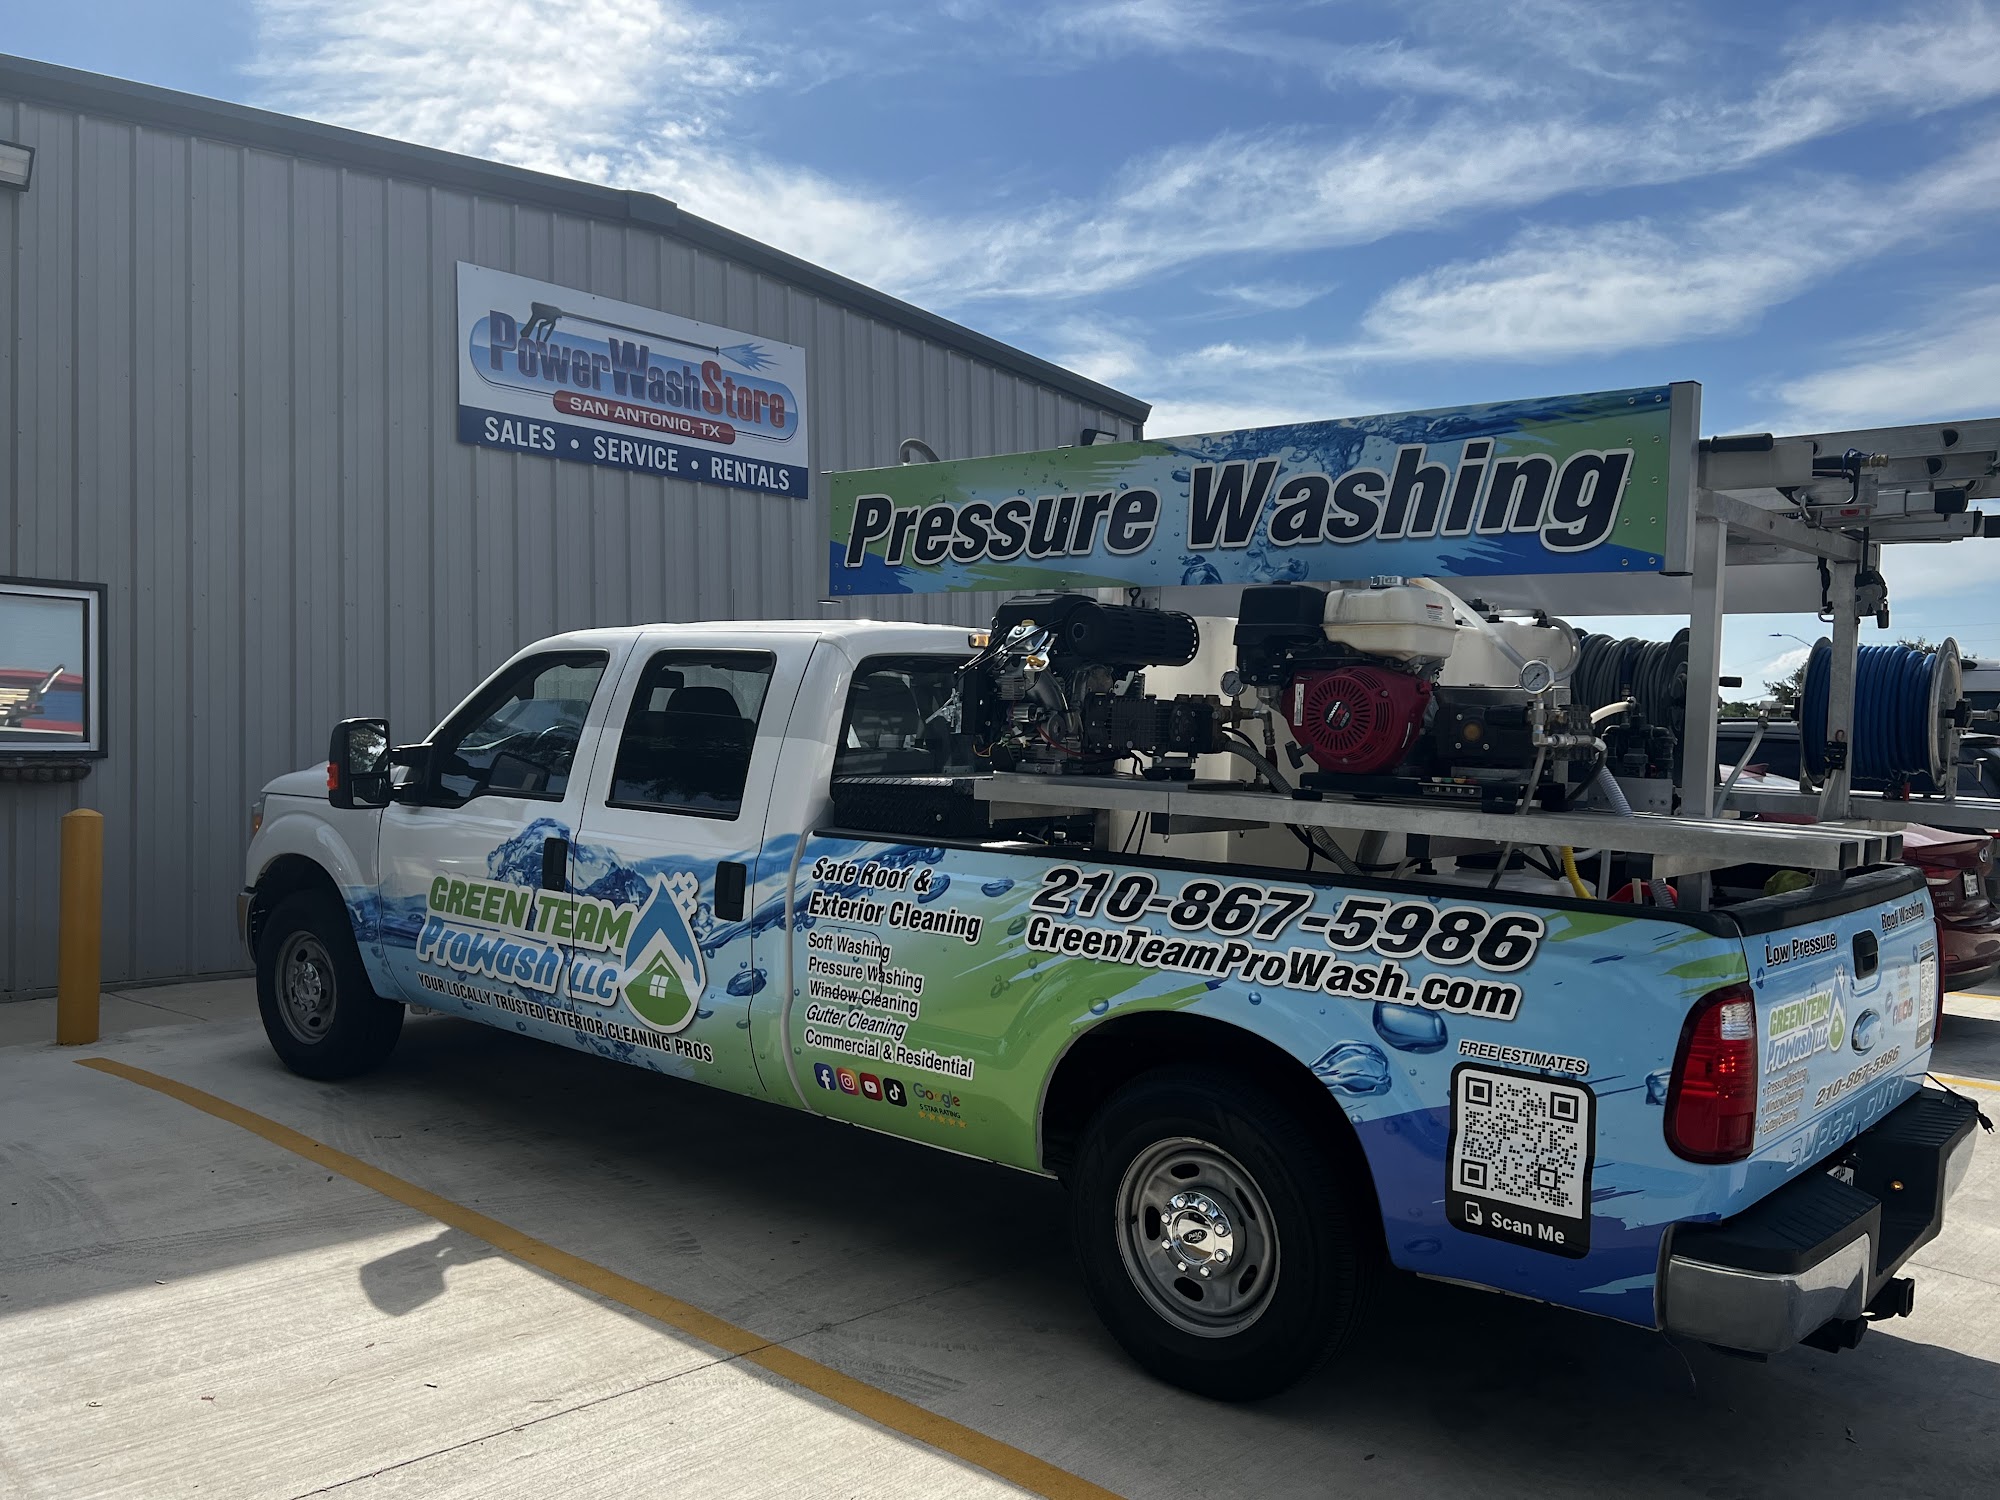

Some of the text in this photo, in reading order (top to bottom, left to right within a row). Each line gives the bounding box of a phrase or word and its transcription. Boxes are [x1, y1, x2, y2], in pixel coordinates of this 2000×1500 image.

[570, 397, 721, 438] SAN ANTONIO, TX
[484, 416, 790, 491] SALES SERVICE RENTALS
[846, 438, 1634, 567] Pressure Washing
[1326, 701, 1341, 723] HONDA
[812, 858, 933, 892] Safe Roof &
[429, 876, 634, 949] GREEN TEAM
[808, 891, 982, 941] Exterior Cleaning
[1031, 867, 1542, 971] 210-867-5986
[1765, 902, 1924, 966] Low Pressure Roof Washing
[420, 916, 618, 999] ProWash LLC
[808, 932, 891, 963] Soft Washing
[1027, 918, 1519, 1019] GreenTeamProWash.com
[808, 957, 923, 993] Pressure Washing
[417, 972, 712, 1063] YOUR LOCALLY TRUSTED EXTERIOR CLEANING PROS
[806, 1004, 906, 1041] Gutter Cleaning
[809, 981, 919, 1017] Window Cleaning
[1770, 991, 1831, 1036] GREEN TEAM
[805, 1029, 973, 1078] Commercial & Residential
[1459, 1040, 1586, 1073] FREE ESTIMATES
[1766, 1027, 1828, 1070] ProWash LLC
[913, 1082, 961, 1108] Google
[1814, 1046, 1900, 1109] 210-867-5986
[1787, 1106, 1856, 1172] SUPER
[1491, 1212, 1565, 1244] Scan Me
